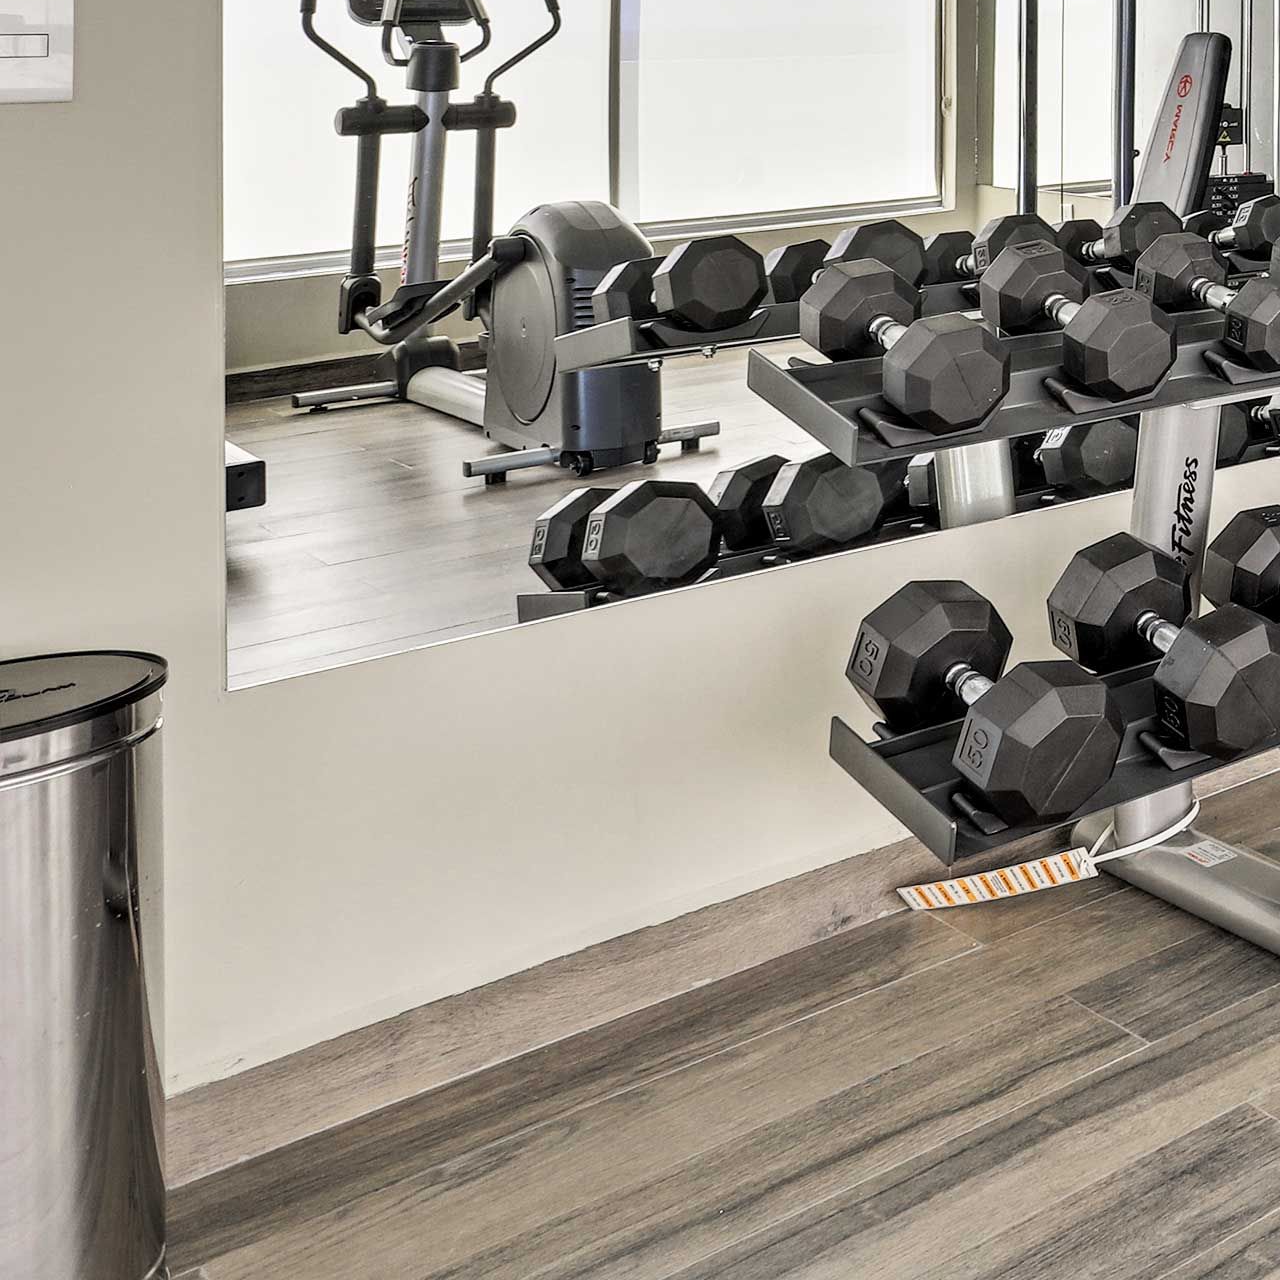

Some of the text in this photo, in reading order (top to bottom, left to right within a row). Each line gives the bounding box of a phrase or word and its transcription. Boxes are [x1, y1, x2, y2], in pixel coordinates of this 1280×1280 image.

[1170, 456, 1200, 557] Fitness
[1054, 617, 1072, 650] 50
[858, 638, 881, 679] 50
[966, 727, 989, 769] 50
